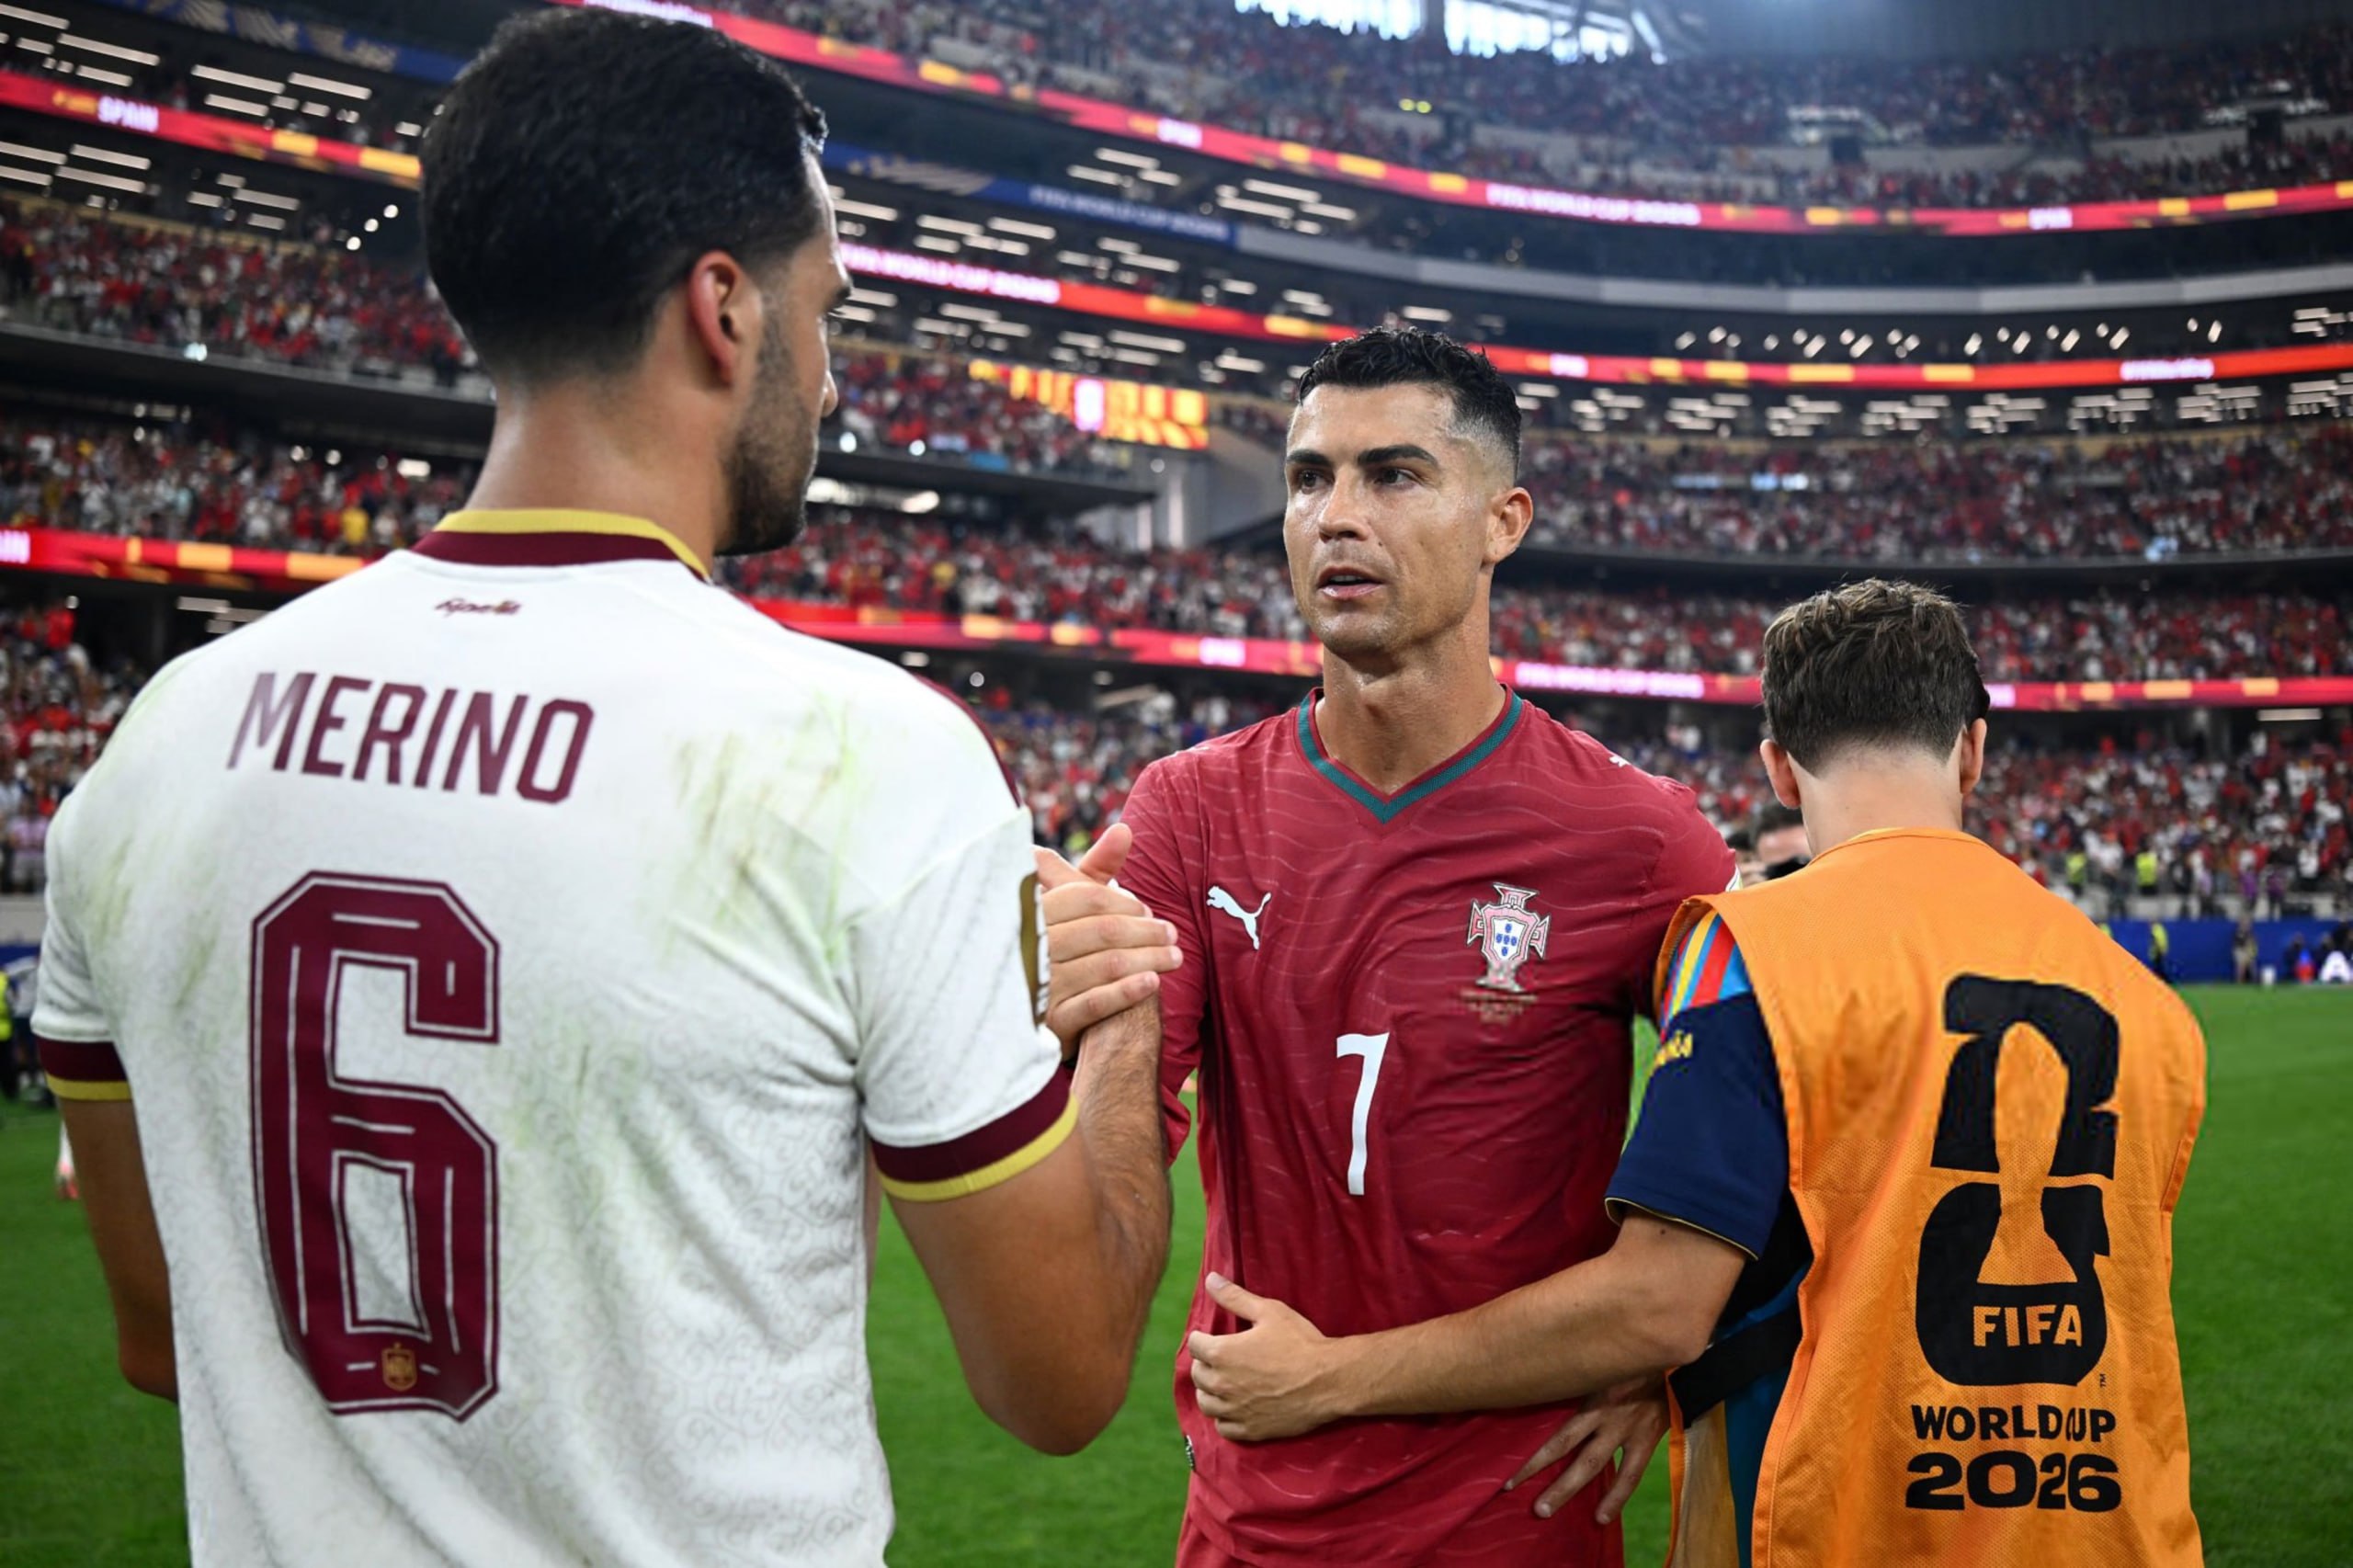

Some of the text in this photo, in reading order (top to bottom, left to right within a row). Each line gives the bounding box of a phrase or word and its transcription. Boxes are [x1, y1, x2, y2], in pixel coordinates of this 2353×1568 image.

[226, 672, 595, 805] MERINO
[252, 869, 500, 1423] 6
[1336, 1031, 1391, 1196] 7
[1972, 1304, 2083, 1347] FIFA
[1911, 1404, 2063, 1441] WORLD
[1905, 1449, 2122, 1513] 2026
